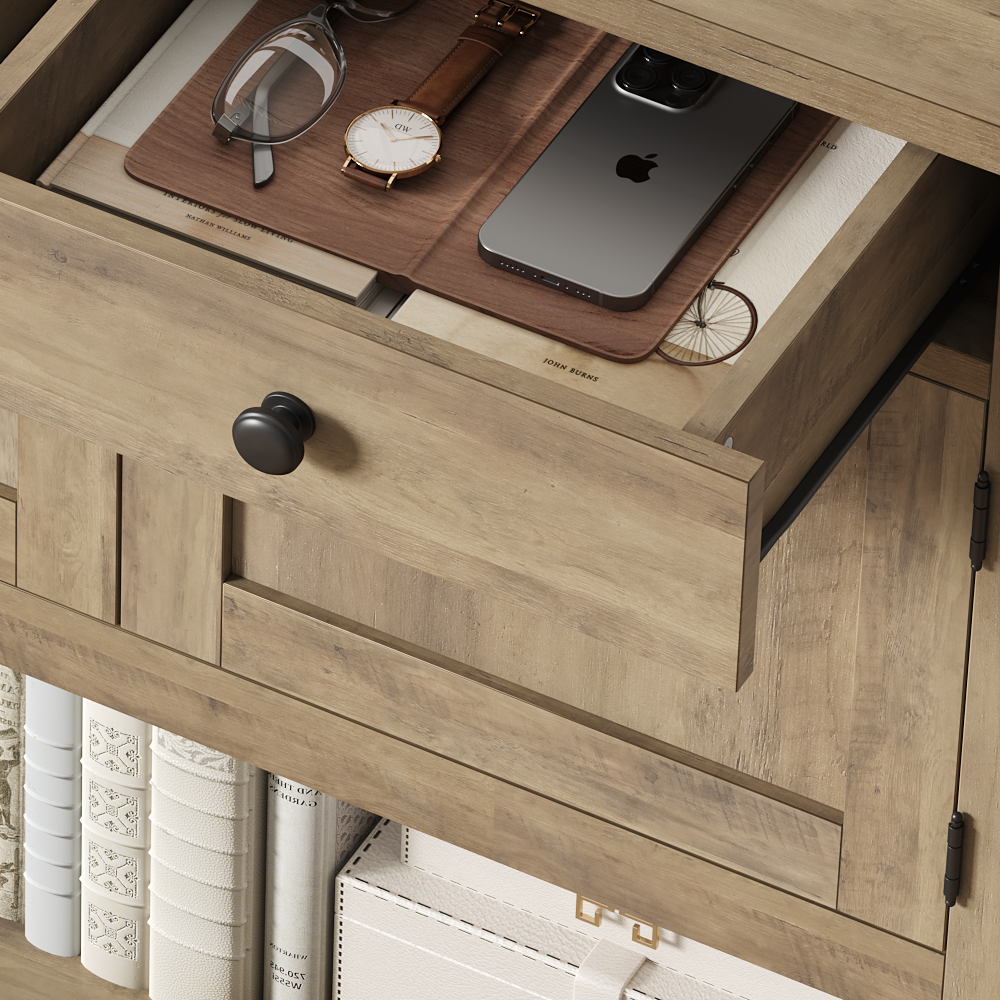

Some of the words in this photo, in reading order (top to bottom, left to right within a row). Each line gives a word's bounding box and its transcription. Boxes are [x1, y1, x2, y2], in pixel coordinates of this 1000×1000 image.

[186, 213, 215, 227] NATHAN
[216, 224, 252, 241] WILLIAMS
[542, 358, 568, 370] JOHN
[569, 368, 599, 382] BURNS
